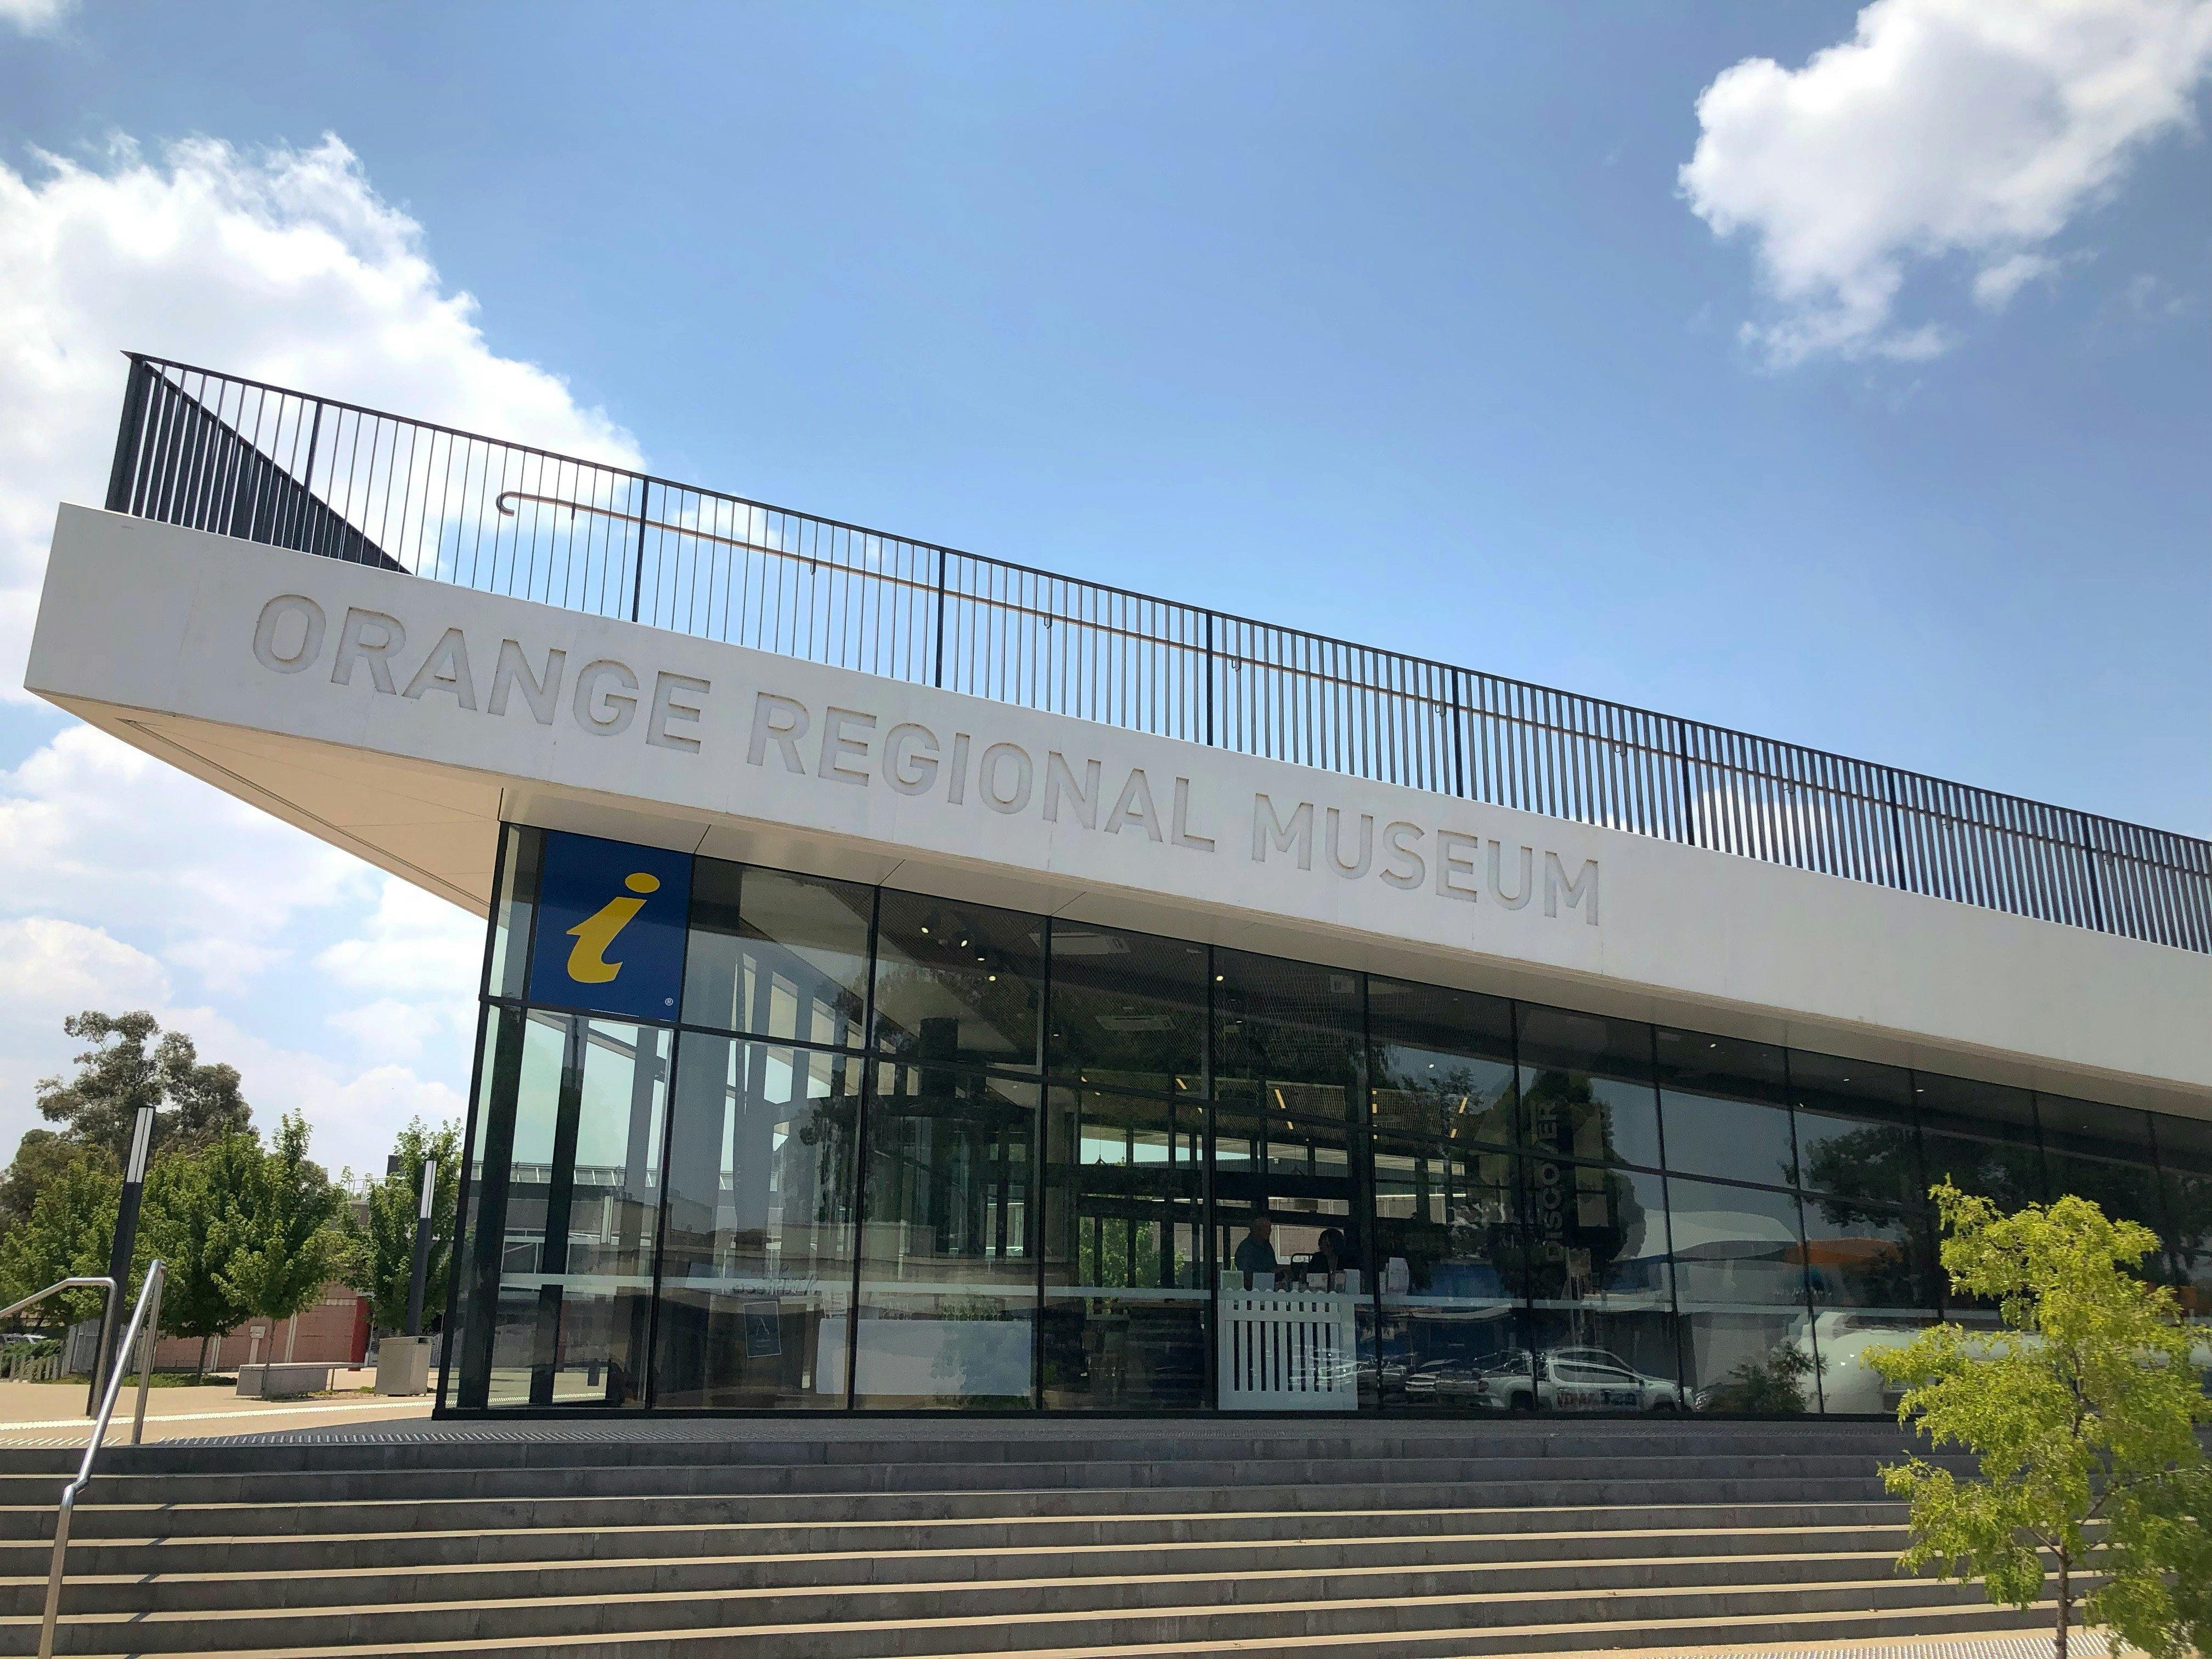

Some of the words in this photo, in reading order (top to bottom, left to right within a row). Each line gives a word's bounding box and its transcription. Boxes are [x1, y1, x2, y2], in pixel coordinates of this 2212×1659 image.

[253, 594, 711, 754] ORANGE
[747, 691, 1215, 853] REGIONAL
[1252, 792, 1599, 926] MUSEUM
